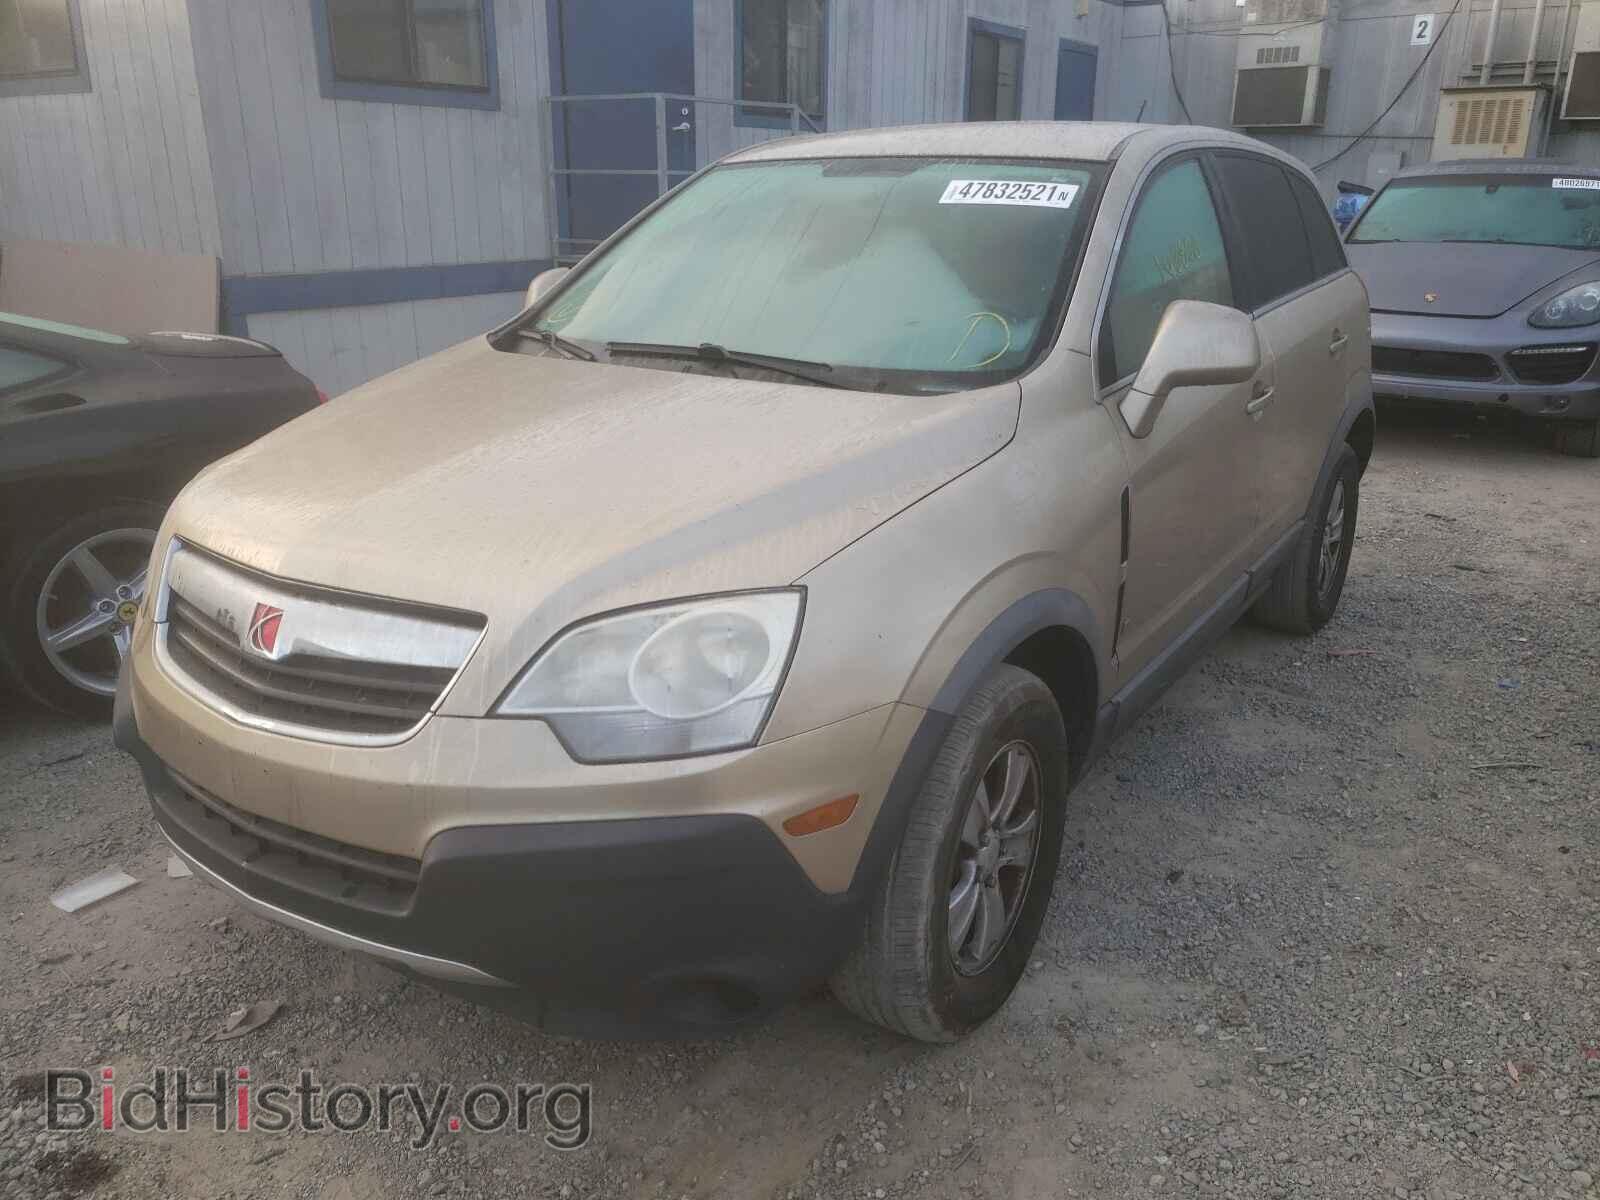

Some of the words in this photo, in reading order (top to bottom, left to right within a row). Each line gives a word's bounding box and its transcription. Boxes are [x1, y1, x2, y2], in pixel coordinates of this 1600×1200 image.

[1416, 20, 1429, 39] 2
[958, 181, 1058, 202] 47832521
[1057, 191, 1070, 201] N
